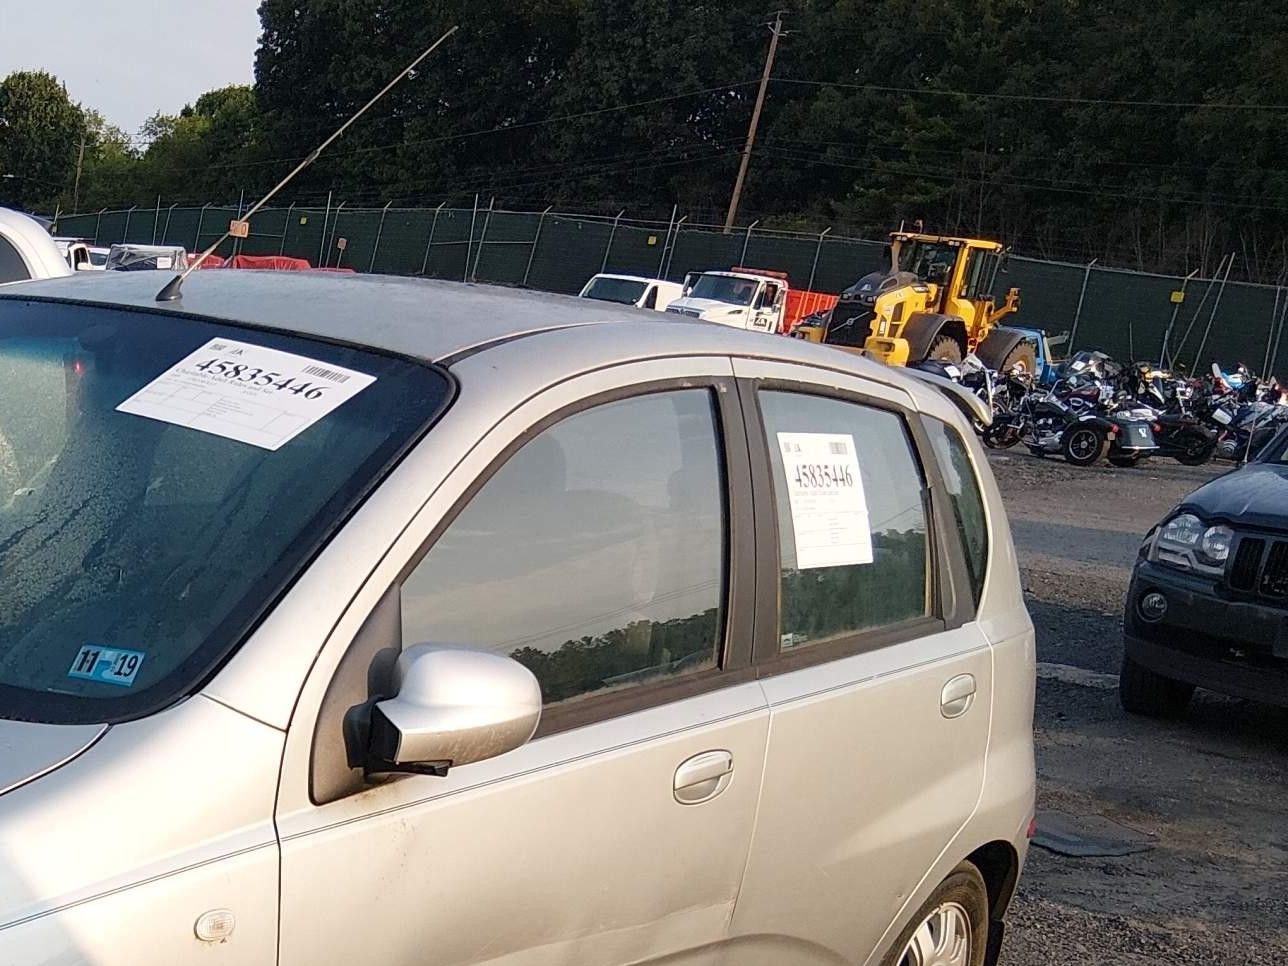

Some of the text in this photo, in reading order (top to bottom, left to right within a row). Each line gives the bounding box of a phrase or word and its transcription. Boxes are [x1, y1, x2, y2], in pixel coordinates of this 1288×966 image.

[195, 357, 331, 400] 45835446
[795, 464, 853, 488] 45835446
[77, 650, 139, 677] 11 19
